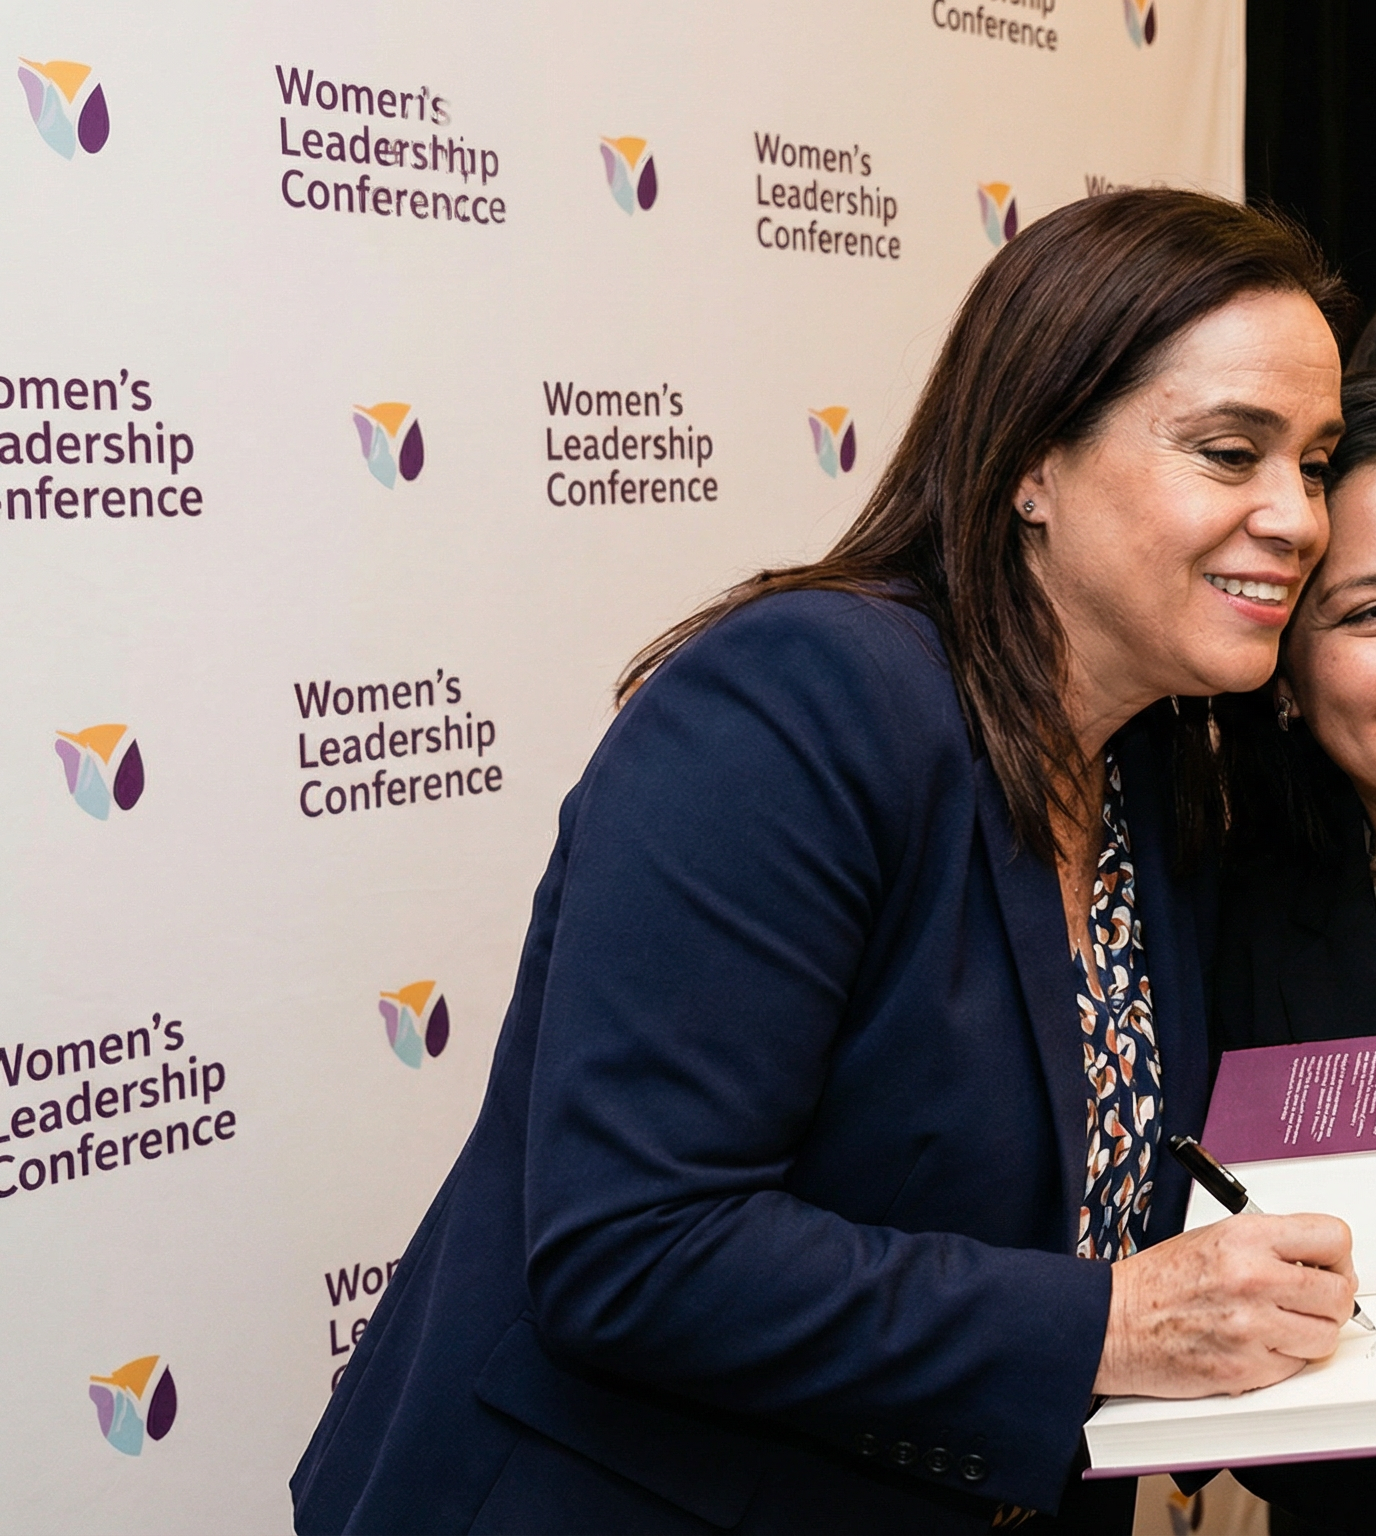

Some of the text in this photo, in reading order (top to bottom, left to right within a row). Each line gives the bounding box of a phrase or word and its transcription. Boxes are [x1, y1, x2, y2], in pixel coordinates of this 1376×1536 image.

[932, 0, 1058, 52] Conference
[753, 131, 872, 177] Women's
[756, 173, 898, 228] Leadership
[756, 216, 901, 260] Conference
[0, 367, 153, 412] omen's
[542, 380, 684, 417] Women's
[0, 420, 195, 476] adership
[546, 424, 714, 469] Leadership
[0, 474, 204, 521] nference
[546, 468, 719, 508] Conference
[293, 667, 462, 720] Women's
[298, 710, 496, 769] Leadership
[299, 764, 503, 819] Conference
